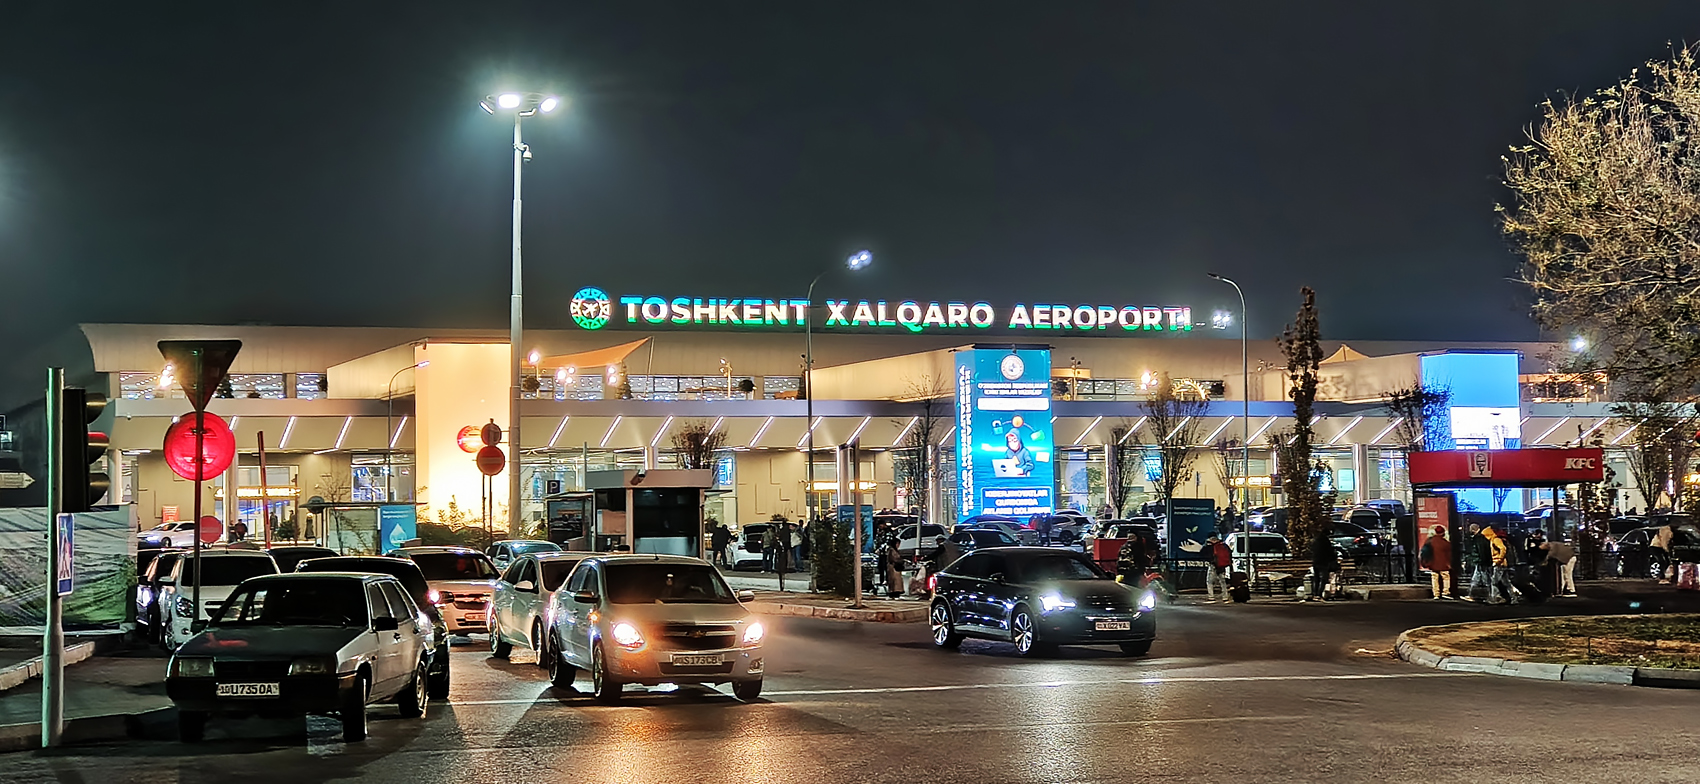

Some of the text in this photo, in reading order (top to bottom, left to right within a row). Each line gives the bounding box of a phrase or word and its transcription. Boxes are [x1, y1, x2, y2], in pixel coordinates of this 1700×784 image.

[620, 295, 1192, 333] TOSHKENT XALQARO AEROPORTI
[1564, 457, 1596, 470] KFC
[550, 481, 558, 493] P
